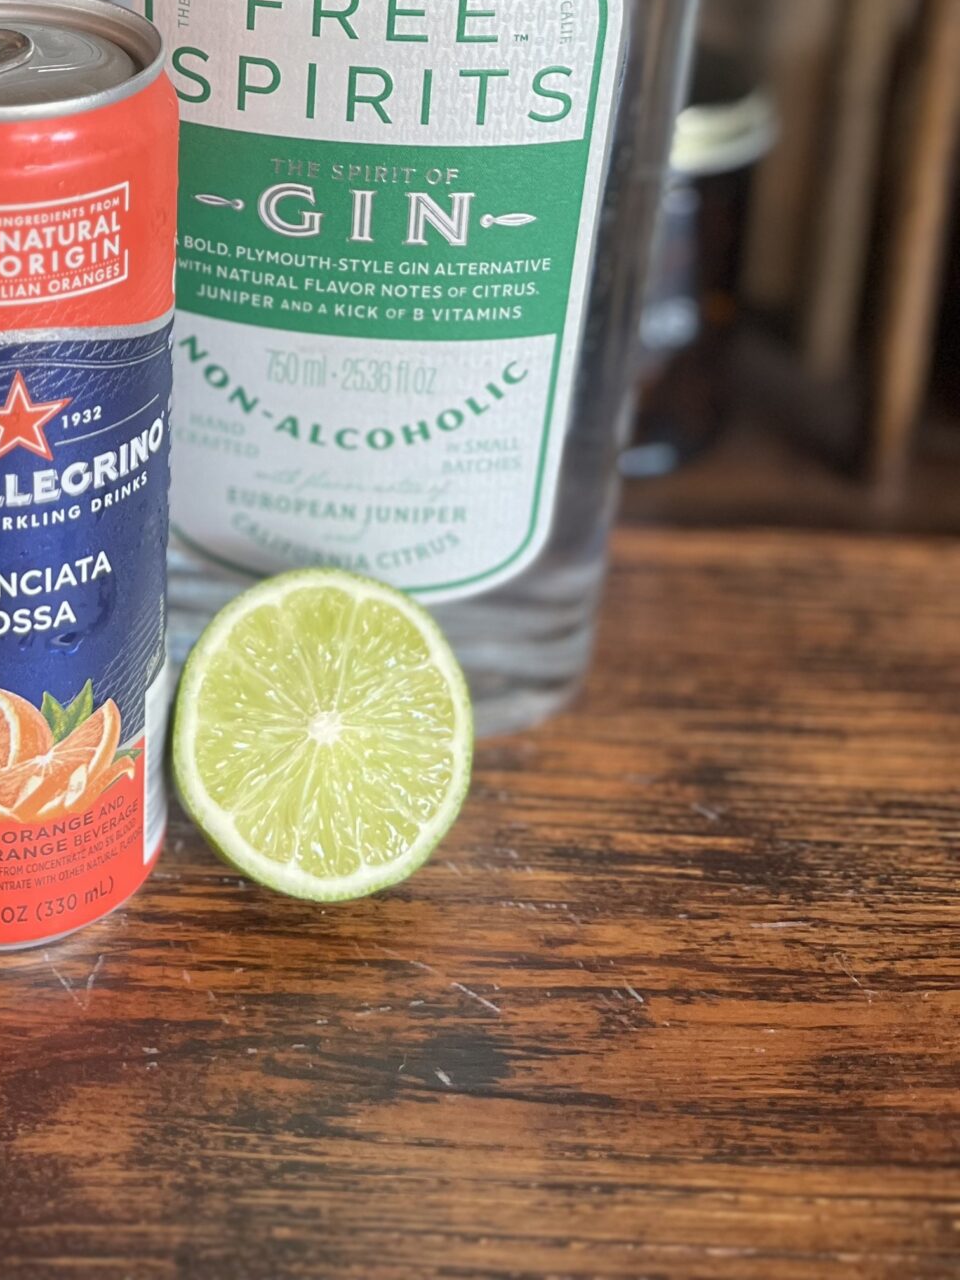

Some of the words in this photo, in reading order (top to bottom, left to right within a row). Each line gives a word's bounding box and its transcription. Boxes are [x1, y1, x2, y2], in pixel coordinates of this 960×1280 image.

[171, 46, 574, 126] SPIRITS
[270, 158, 321, 178] THE
[331, 163, 416, 185] SPIRIT
[425, 167, 459, 185] OF
[90, 196, 120, 215] FROM
[258, 183, 475, 246] GIN
[48, 263, 120, 293] ORANGES
[178, 258, 212, 273] WITH
[216, 265, 298, 290] NATURAL
[304, 278, 375, 296] FLAVOR
[382, 284, 442, 299] NOTES
[447, 286, 468, 298] OF
[236, 245, 394, 274] PLYMOUTH-STYLE
[398, 261, 430, 276] GIN
[433, 257, 552, 276] ALTERNATIVE
[196, 284, 274, 309] JUNIPER
[280, 299, 313, 313] AND
[317, 303, 328, 314] A
[334, 303, 378, 320] KICK
[385, 308, 406, 319] OF
[413, 308, 425, 321] B
[431, 305, 523, 321] VITAMINS
[264, 347, 299, 385] 750
[303, 354, 327, 388] ml
[178, 335, 529, 452] NON-ALCOHOLIC
[61, 406, 103, 429] 1932
[91, 471, 148, 513] DRINKS
[226, 485, 356, 521] EUROPEAN
[363, 503, 467, 525] JUNIPER
[375, 531, 462, 570] CITRUS
[1, 811, 94, 845] ORANGE
[98, 795, 125, 819] AND
[73, 799, 139, 847] BEVERAGE
[26, 849, 86, 874] CONCENTRATE
[34, 873, 56, 886] WITH
[58, 865, 85, 881] OTHER
[0, 905, 29, 924] OZ
[35, 893, 77, 922] (330
[84, 876, 115, 905] mL)
